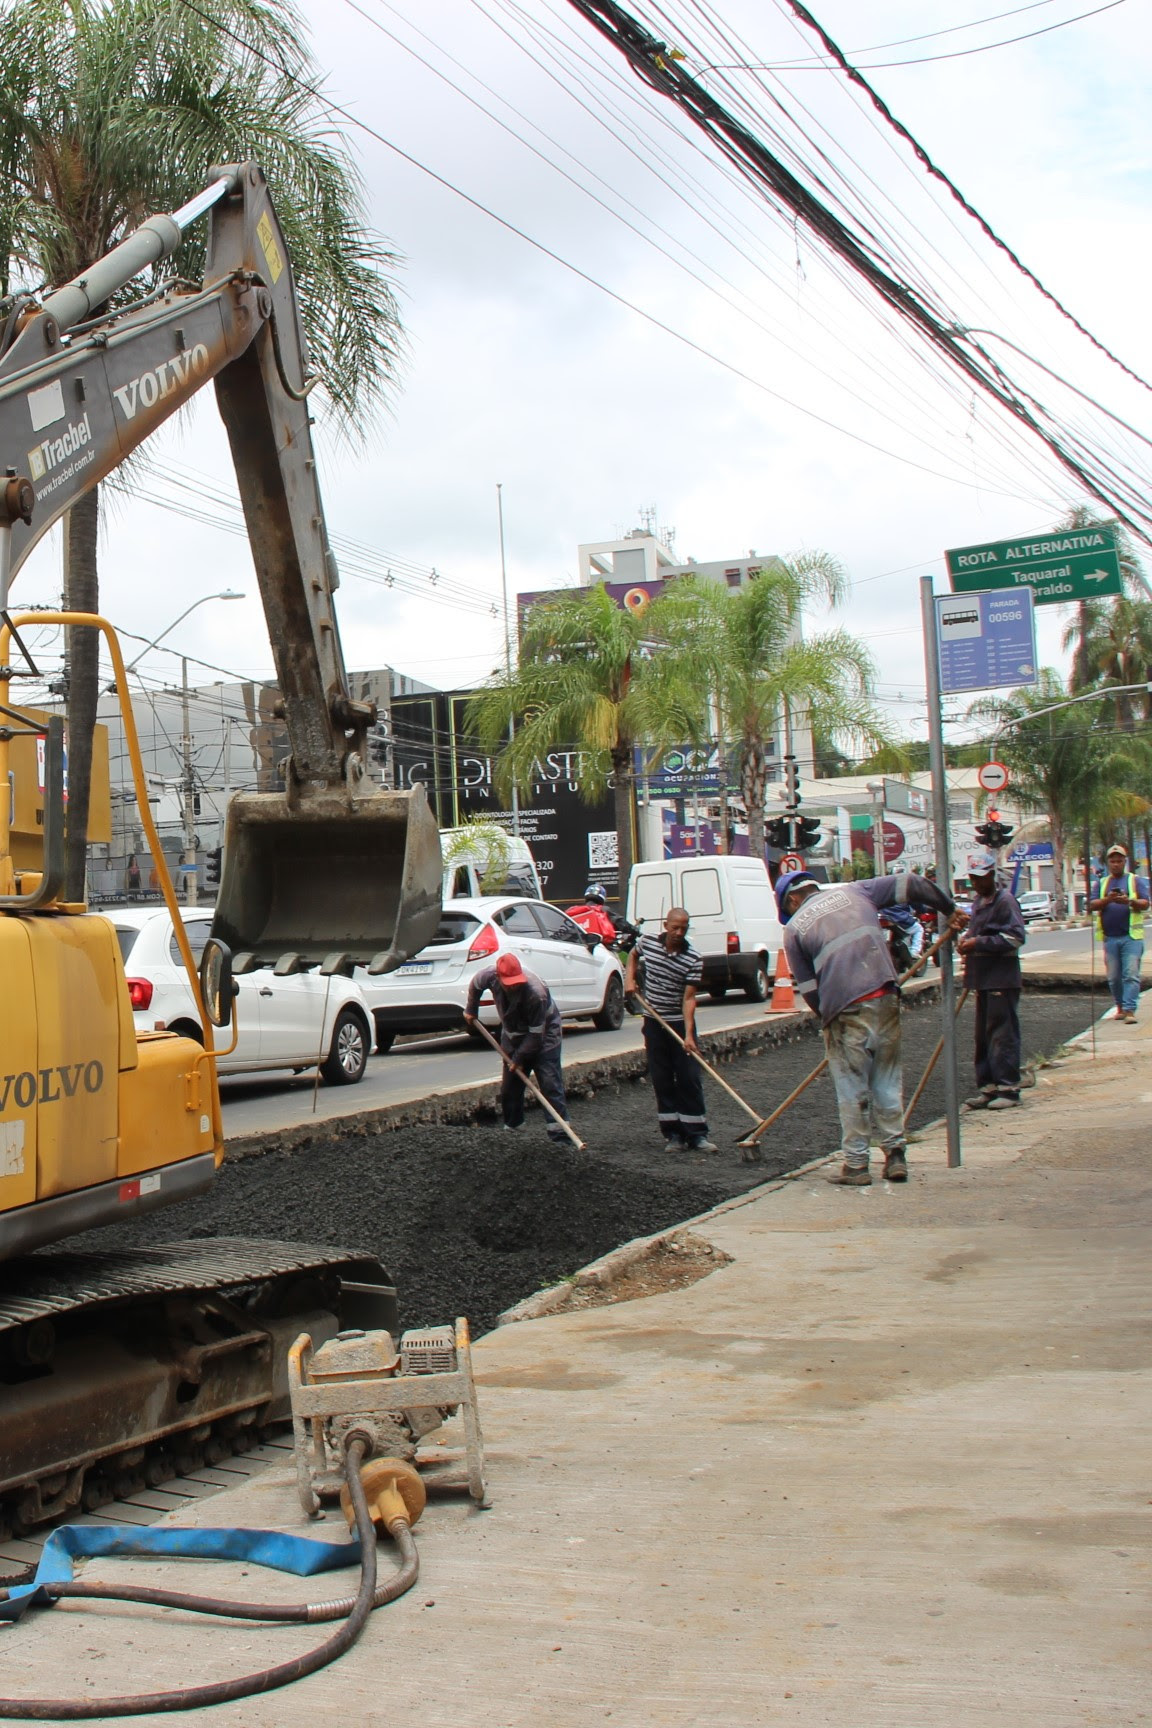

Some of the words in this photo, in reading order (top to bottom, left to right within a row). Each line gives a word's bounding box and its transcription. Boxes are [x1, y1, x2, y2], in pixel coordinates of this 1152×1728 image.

[113, 343, 210, 421] VOLVO
[41, 412, 92, 470] Tracbel
[957, 550, 998, 567] ROTA
[1005, 533, 1104, 560] ALTERNATIVA
[1011, 565, 1071, 584] Taquaral
[1031, 582, 1073, 598] eraldo
[989, 599, 1019, 608] PARADA
[988, 611, 1022, 623] 00596
[519, 808, 557, 817] SPECIALIZADA
[532, 833, 559, 842] CONTATO
[1008, 853, 1052, 861] JALECOS
